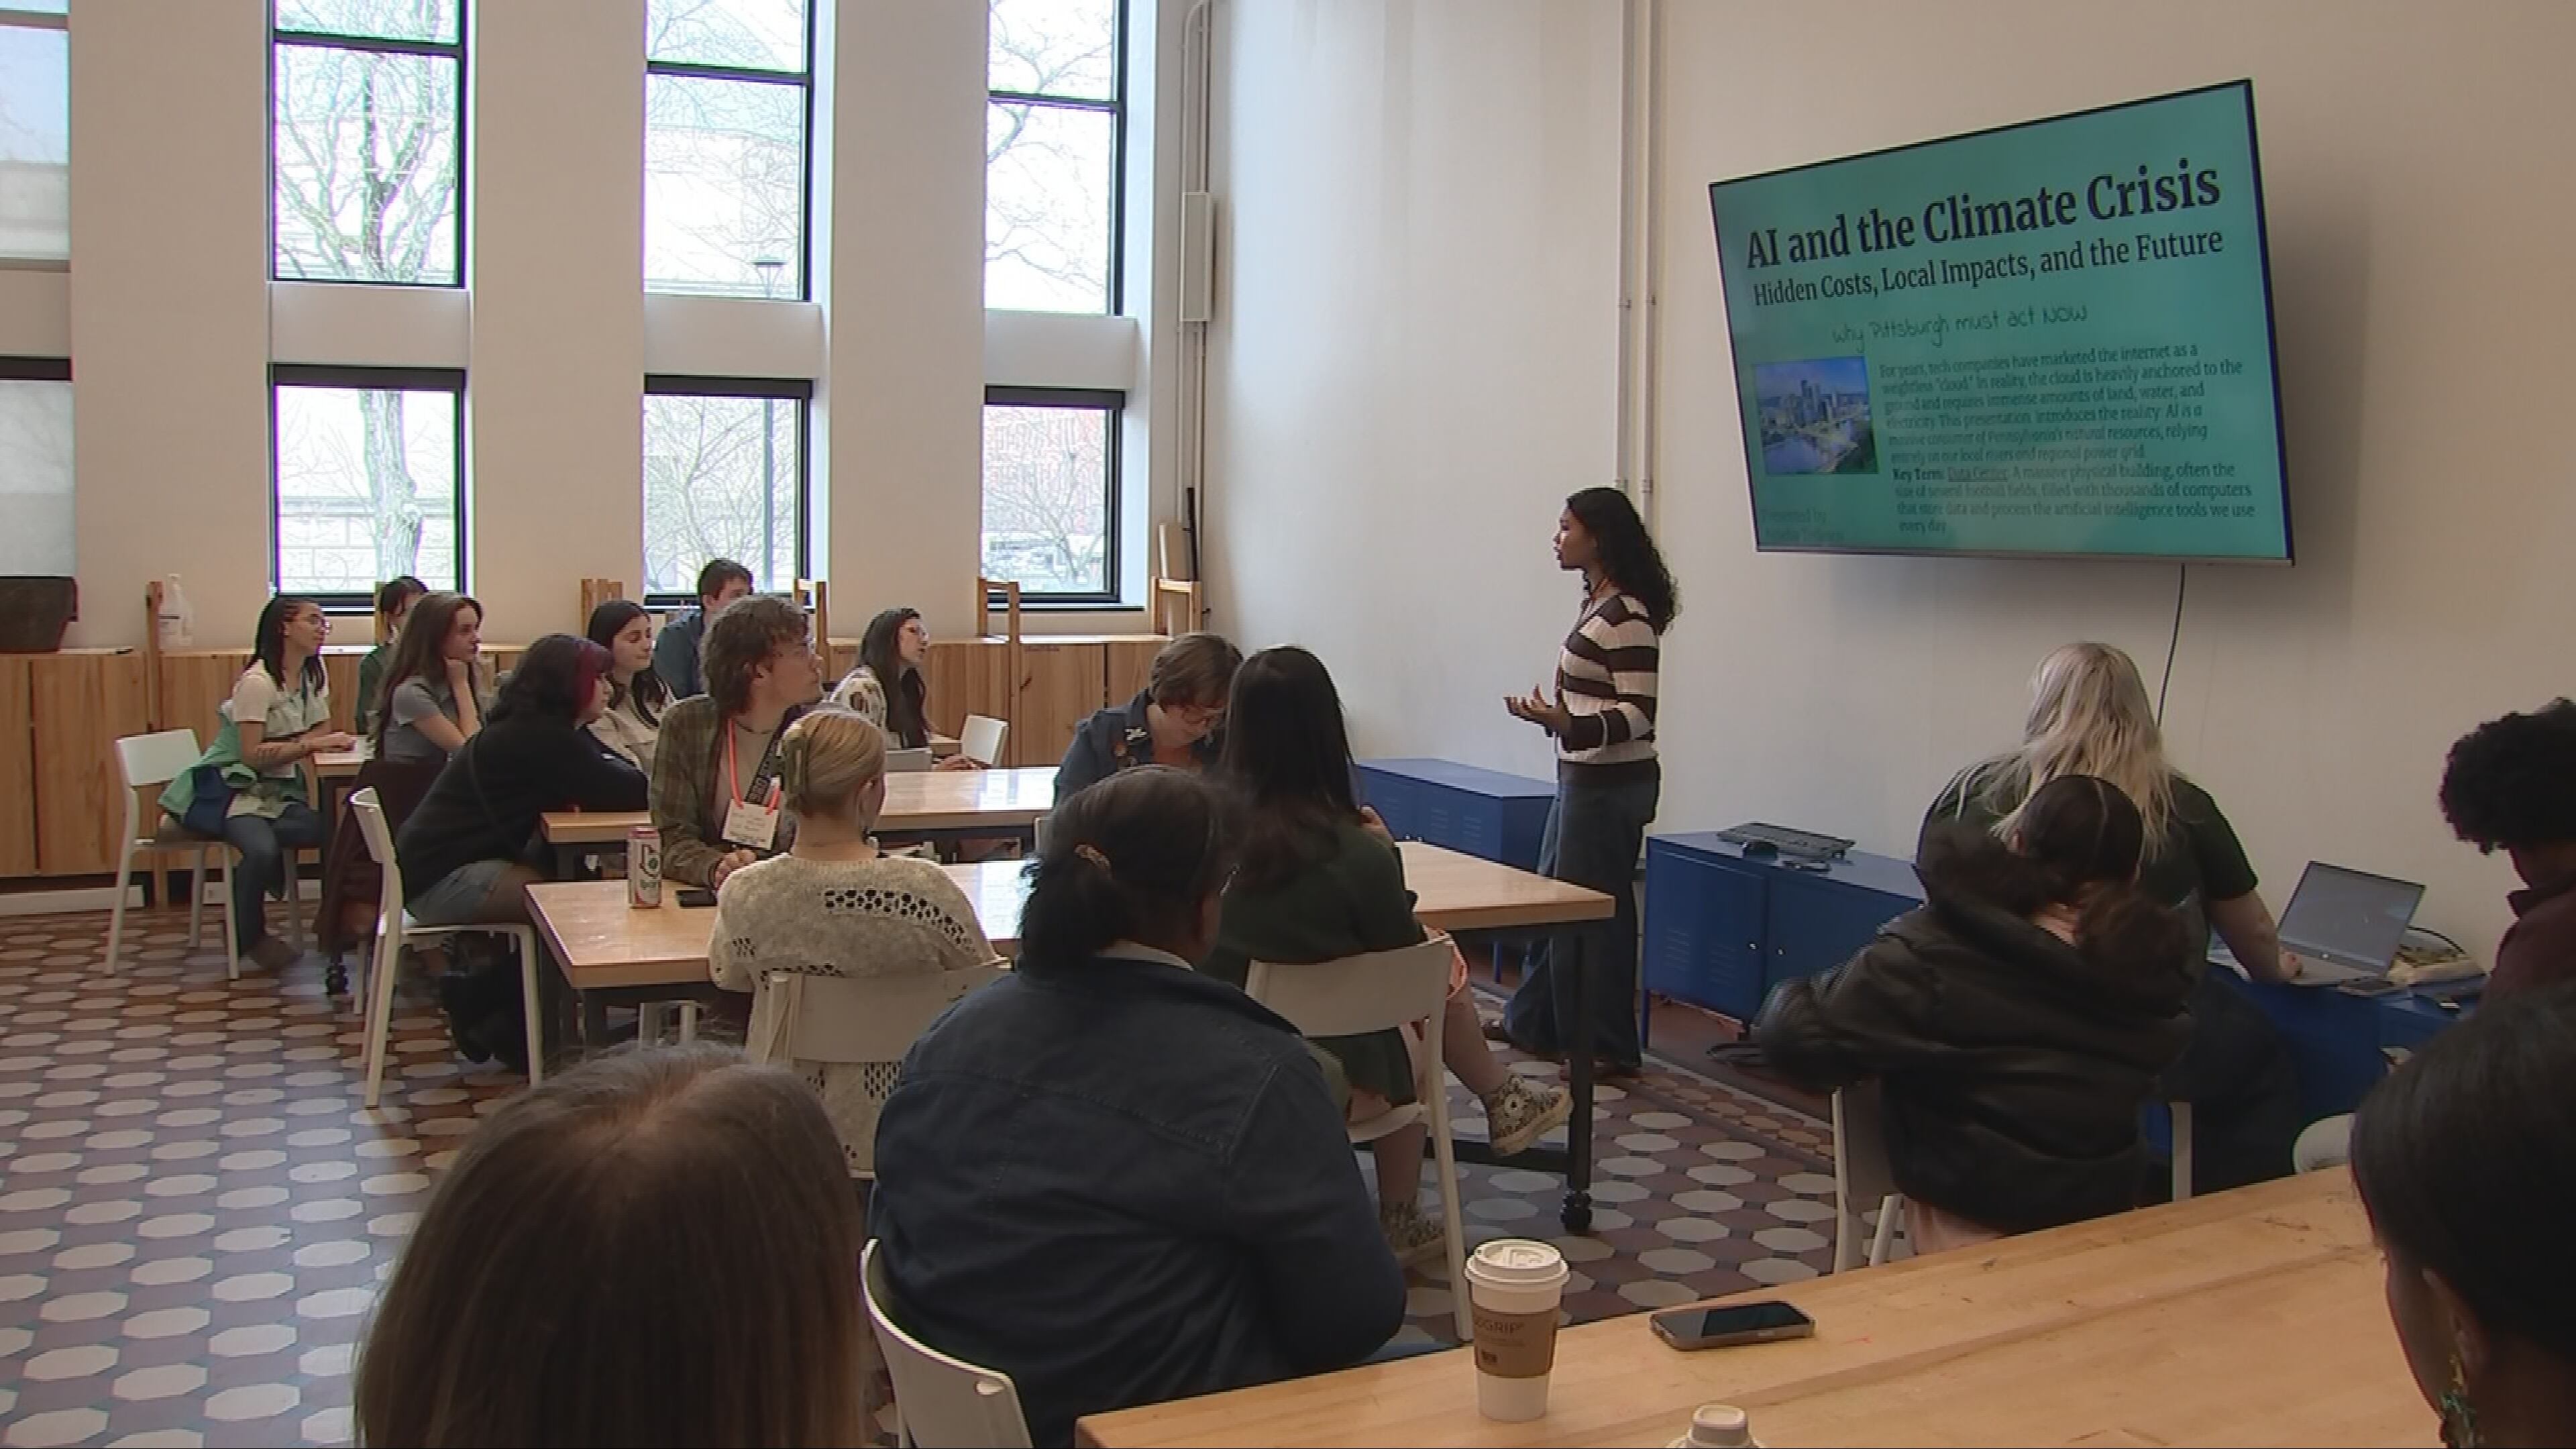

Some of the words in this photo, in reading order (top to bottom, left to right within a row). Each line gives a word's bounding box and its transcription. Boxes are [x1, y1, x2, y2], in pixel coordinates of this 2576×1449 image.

[1748, 227, 1782, 269] AI
[1788, 213, 1851, 263] and
[1857, 207, 1915, 253] the
[1923, 186, 2077, 244] Climate
[2087, 158, 2220, 220] Crisis
[1754, 278, 1819, 306] Hidden
[1821, 273, 1878, 300] Costs,
[1881, 260, 1937, 292] Local
[1940, 253, 2036, 288] Impacts,
[2040, 240, 2084, 273] and
[2090, 237, 2130, 266] the
[2135, 230, 2224, 262] Future
[1868, 313, 1949, 347] Pittsburgh
[1955, 309, 1999, 331] must
[2006, 305, 2035, 327] act
[2042, 305, 2088, 325] NOW
[2012, 354, 2039, 368] have
[2040, 347, 2096, 366] marketed
[2098, 347, 2118, 362] the
[2120, 345, 2171, 362] internet
[2173, 344, 2187, 357] as
[2190, 344, 2198, 356] a
[2029, 371, 2047, 386] the
[2048, 369, 2080, 384] cloud
[2082, 370, 2094, 383] is
[2095, 365, 2139, 384] heavily
[2141, 361, 2200, 379] anchored
[2203, 363, 2218, 376] to
[2220, 358, 2243, 375] the
[2039, 389, 2090, 405] amounts
[2092, 386, 2104, 401] of
[2179, 380, 2204, 397] and
[2098, 406, 2118, 421] the
[2165, 404, 2179, 419] AI
[2107, 425, 2164, 441] resources,
[2165, 423, 2207, 441] relying
[1892, 468, 1912, 483] Key
[2118, 462, 2174, 482] building,
[2176, 461, 2210, 477] often
[2212, 462, 2236, 477] the
[2166, 482, 2180, 497] of
[2182, 484, 2253, 501] computers
[2104, 501, 2174, 520] intelligence
[2176, 500, 2207, 517] tools
[2208, 504, 2230, 517] we
[2231, 504, 2255, 517] use
